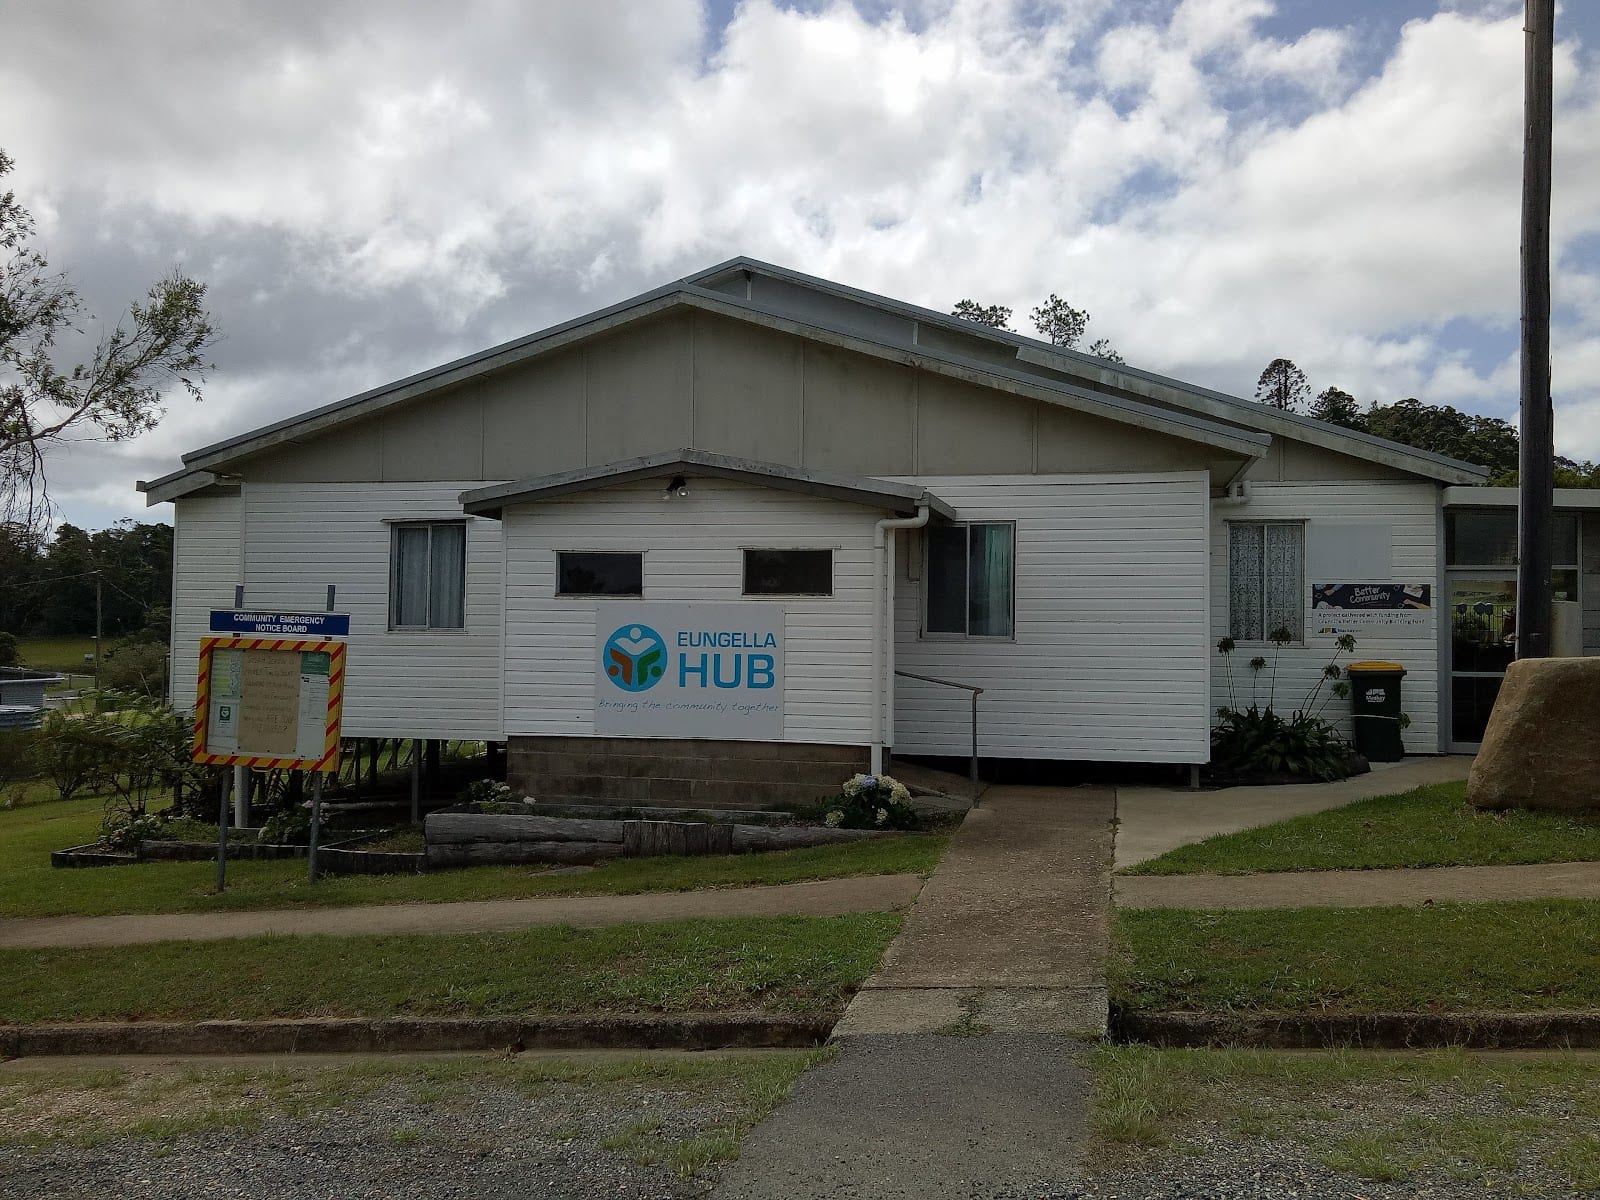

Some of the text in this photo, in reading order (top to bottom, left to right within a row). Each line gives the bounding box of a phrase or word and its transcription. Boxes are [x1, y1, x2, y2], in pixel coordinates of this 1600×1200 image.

[1349, 591, 1390, 603] Community
[1354, 586, 1380, 596] Better
[233, 613, 325, 624] COMMUNITY EMERGENCY
[255, 624, 308, 633] NOTICE BOARD
[677, 631, 777, 648] EUNGELLA
[679, 652, 775, 689] HUB
[598, 699, 780, 716] Bringing the community together
